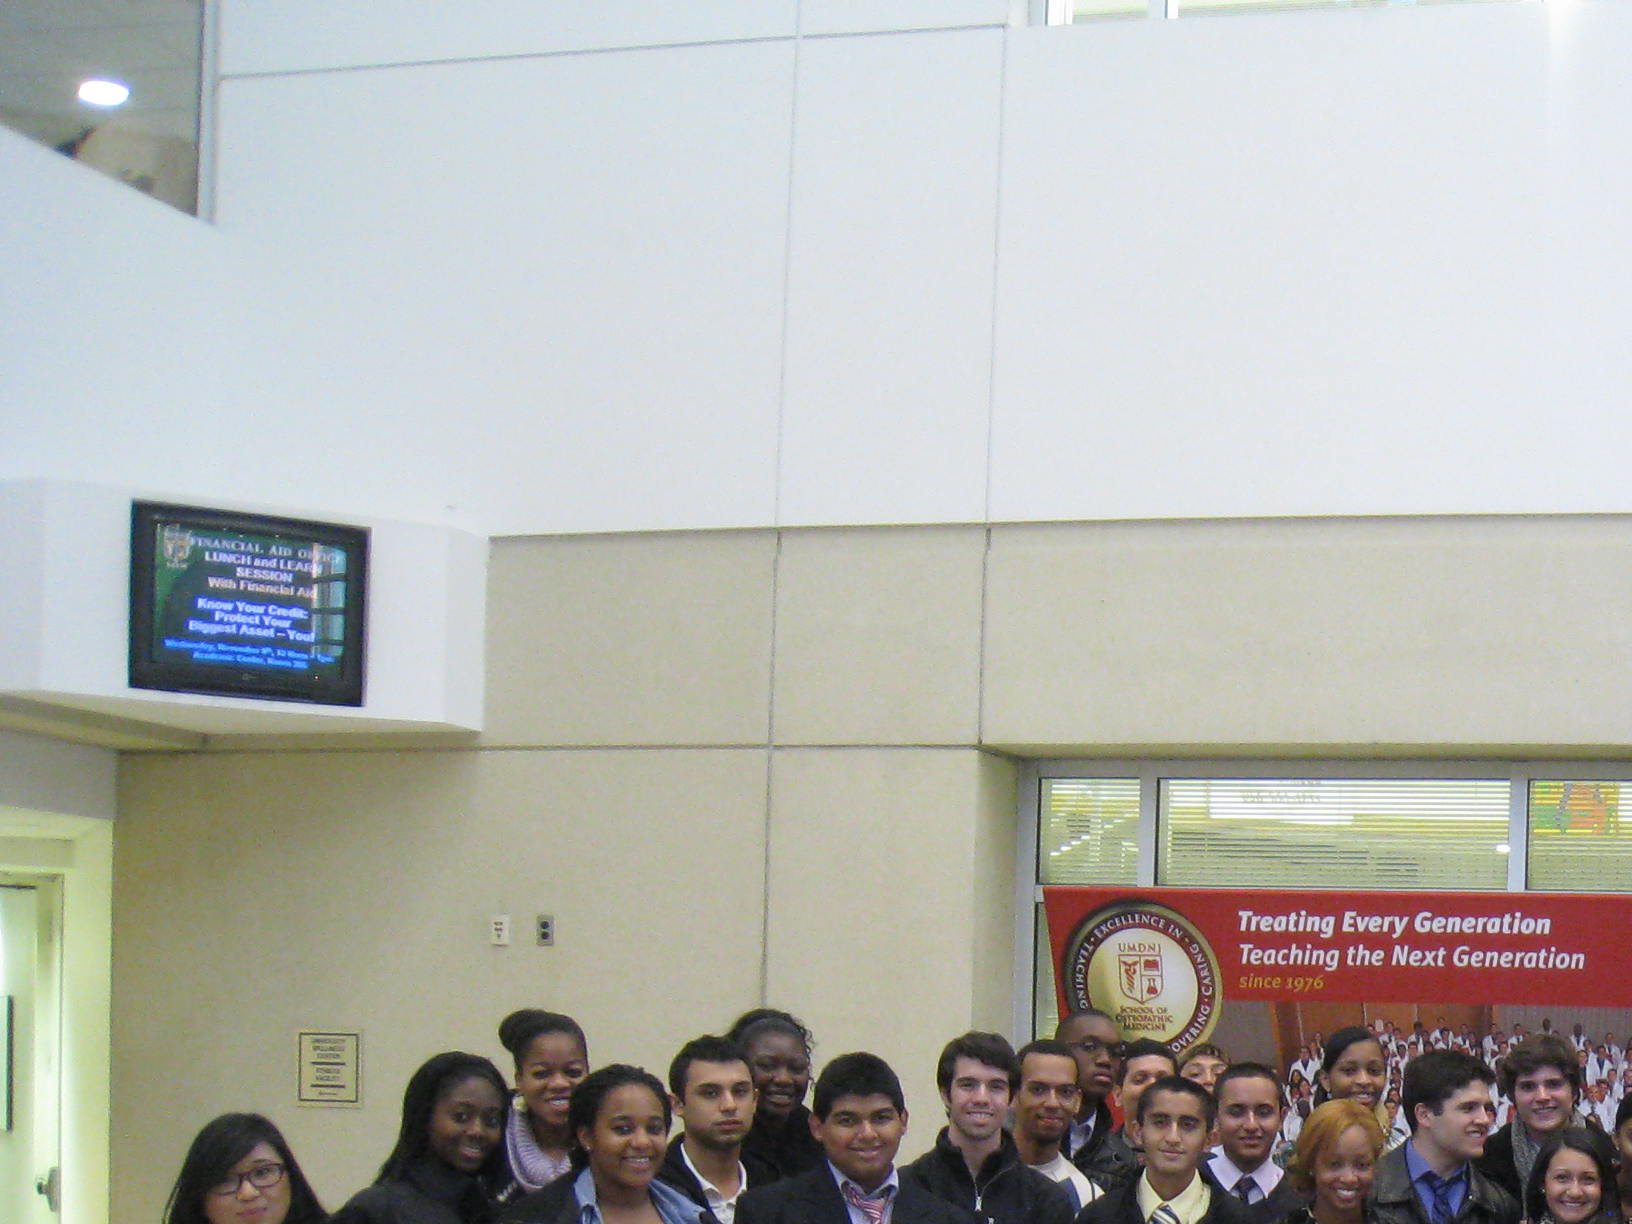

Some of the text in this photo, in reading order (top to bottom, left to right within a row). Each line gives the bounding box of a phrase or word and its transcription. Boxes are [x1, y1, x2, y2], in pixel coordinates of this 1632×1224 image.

[204, 551, 252, 566] LUNCH
[253, 554, 277, 568] and
[268, 545, 292, 557] AID
[236, 566, 293, 582] SESSION
[207, 576, 237, 590] With
[239, 580, 294, 596] Financial
[196, 597, 309, 620] Know Your Credit:
[188, 619, 237, 635] Biggest
[239, 624, 276, 638] Asset
[214, 610, 292, 629] Protect Your
[1092, 912, 1166, 939] EXCELLENCE
[1238, 909, 1551, 938] Treating Every Generation
[1117, 942, 1162, 954] UMDNJ
[1239, 943, 1585, 971] Teaching the Next Generation
[1074, 941, 1095, 1010] TEACHING
[1188, 943, 1214, 997] CARING
[1238, 973, 1325, 993] since 1976
[1167, 1005, 1212, 1054] OVERING
